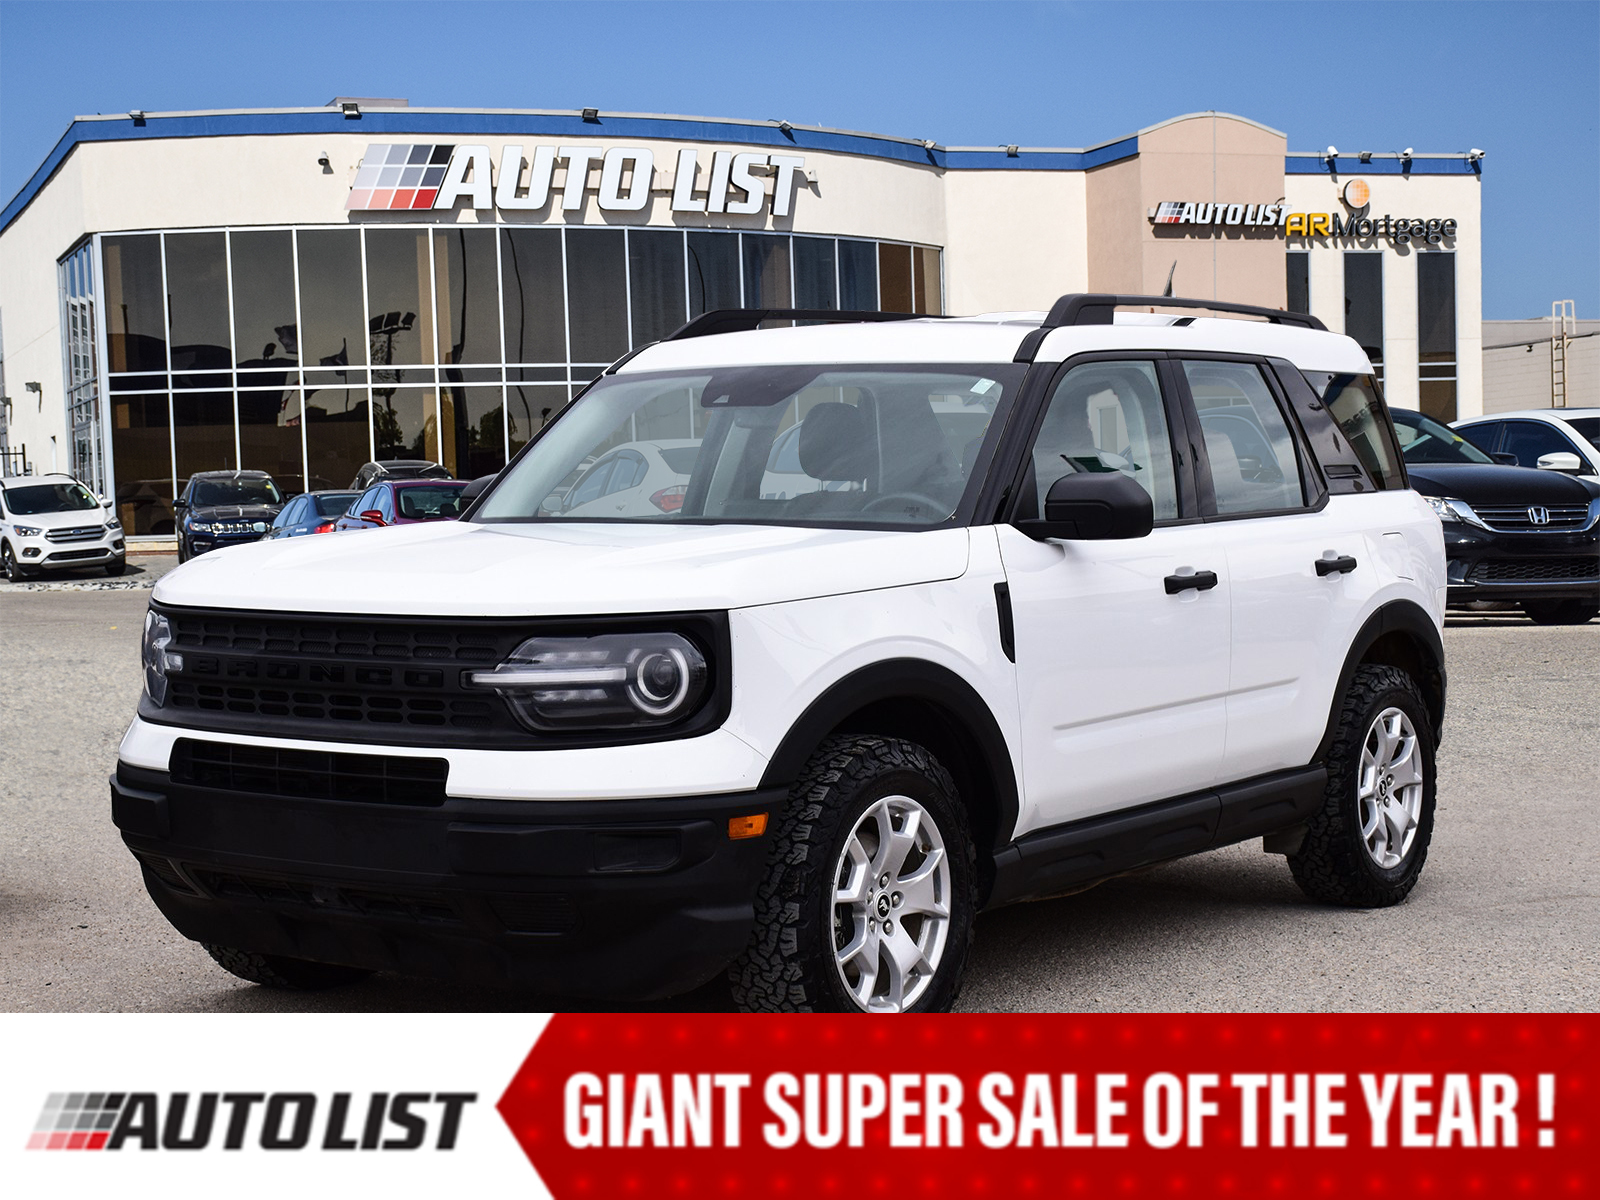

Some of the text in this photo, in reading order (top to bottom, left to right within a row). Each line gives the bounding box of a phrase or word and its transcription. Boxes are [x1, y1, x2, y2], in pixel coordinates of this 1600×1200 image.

[433, 144, 806, 216] AUTO LIST
[1179, 201, 1292, 227] AUTO LIST
[1285, 212, 1458, 245] AR Mortgage
[191, 655, 445, 688] BRONCO
